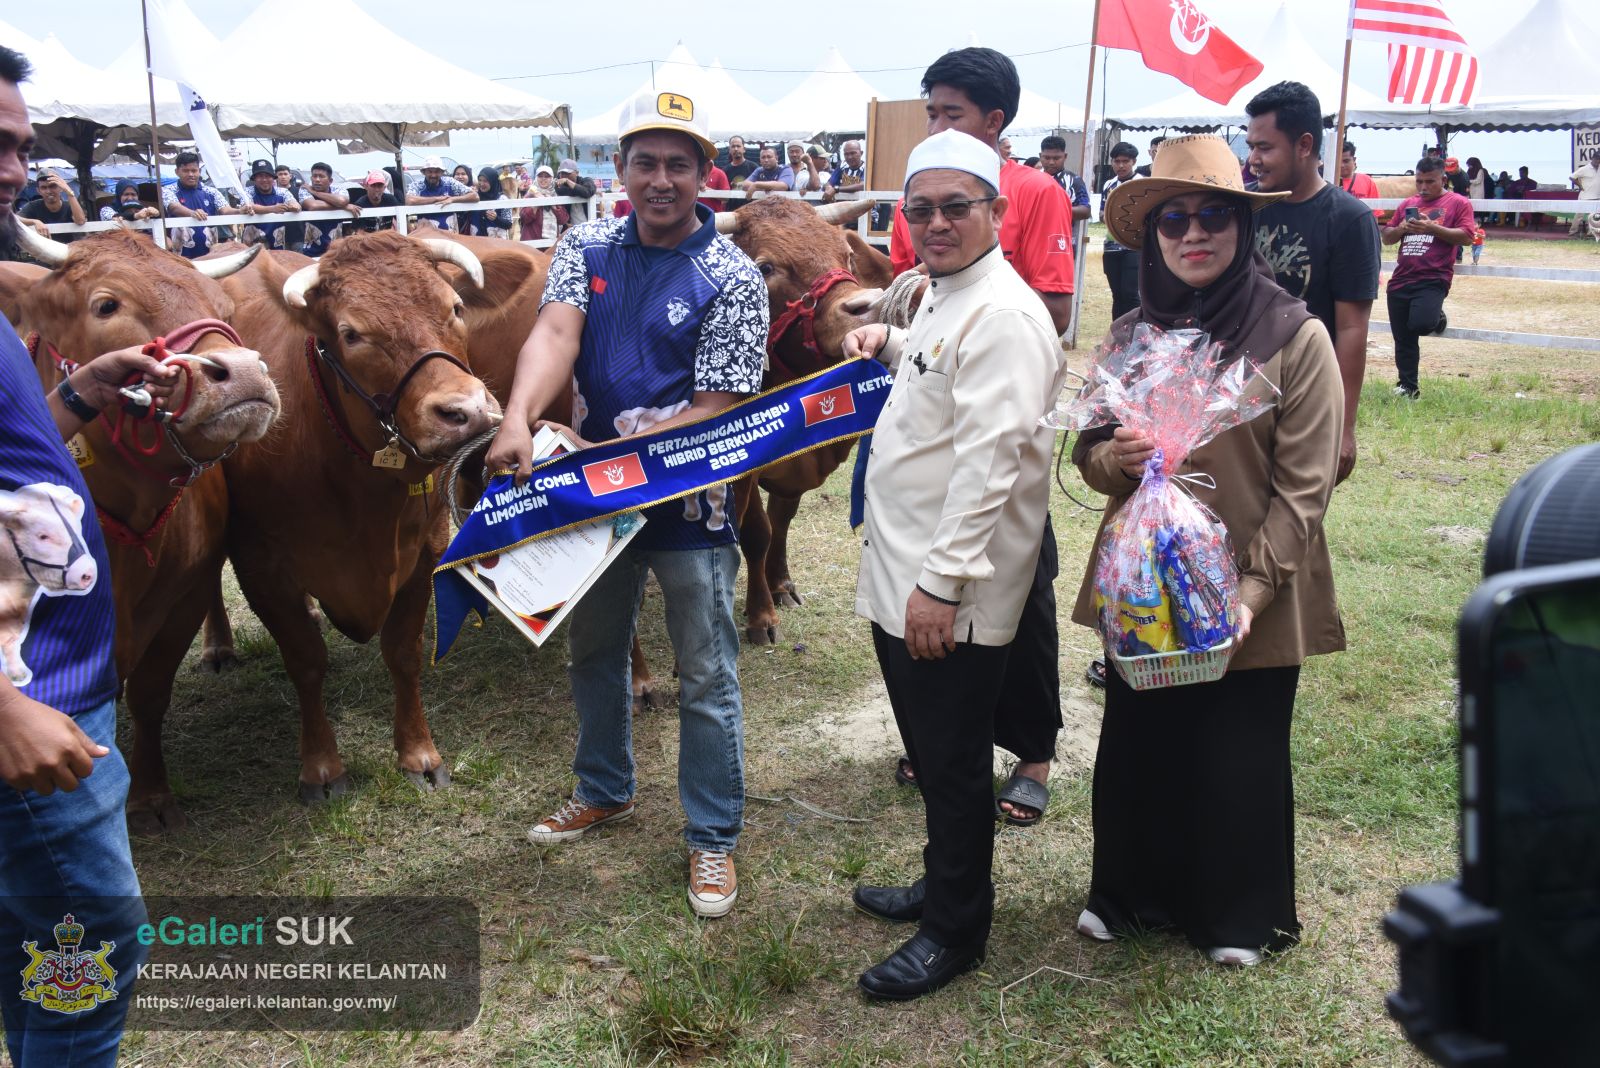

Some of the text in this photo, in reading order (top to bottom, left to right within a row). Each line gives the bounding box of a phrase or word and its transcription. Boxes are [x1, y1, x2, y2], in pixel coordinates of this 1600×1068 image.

[648, 402, 790, 457] PERTANDINGAN LEMBU
[663, 418, 785, 468] HIBRID BERKUALITI
[709, 448, 749, 471] 2025
[534, 471, 581, 492] COMEL
[484, 494, 549, 526] LIMOUSIN
